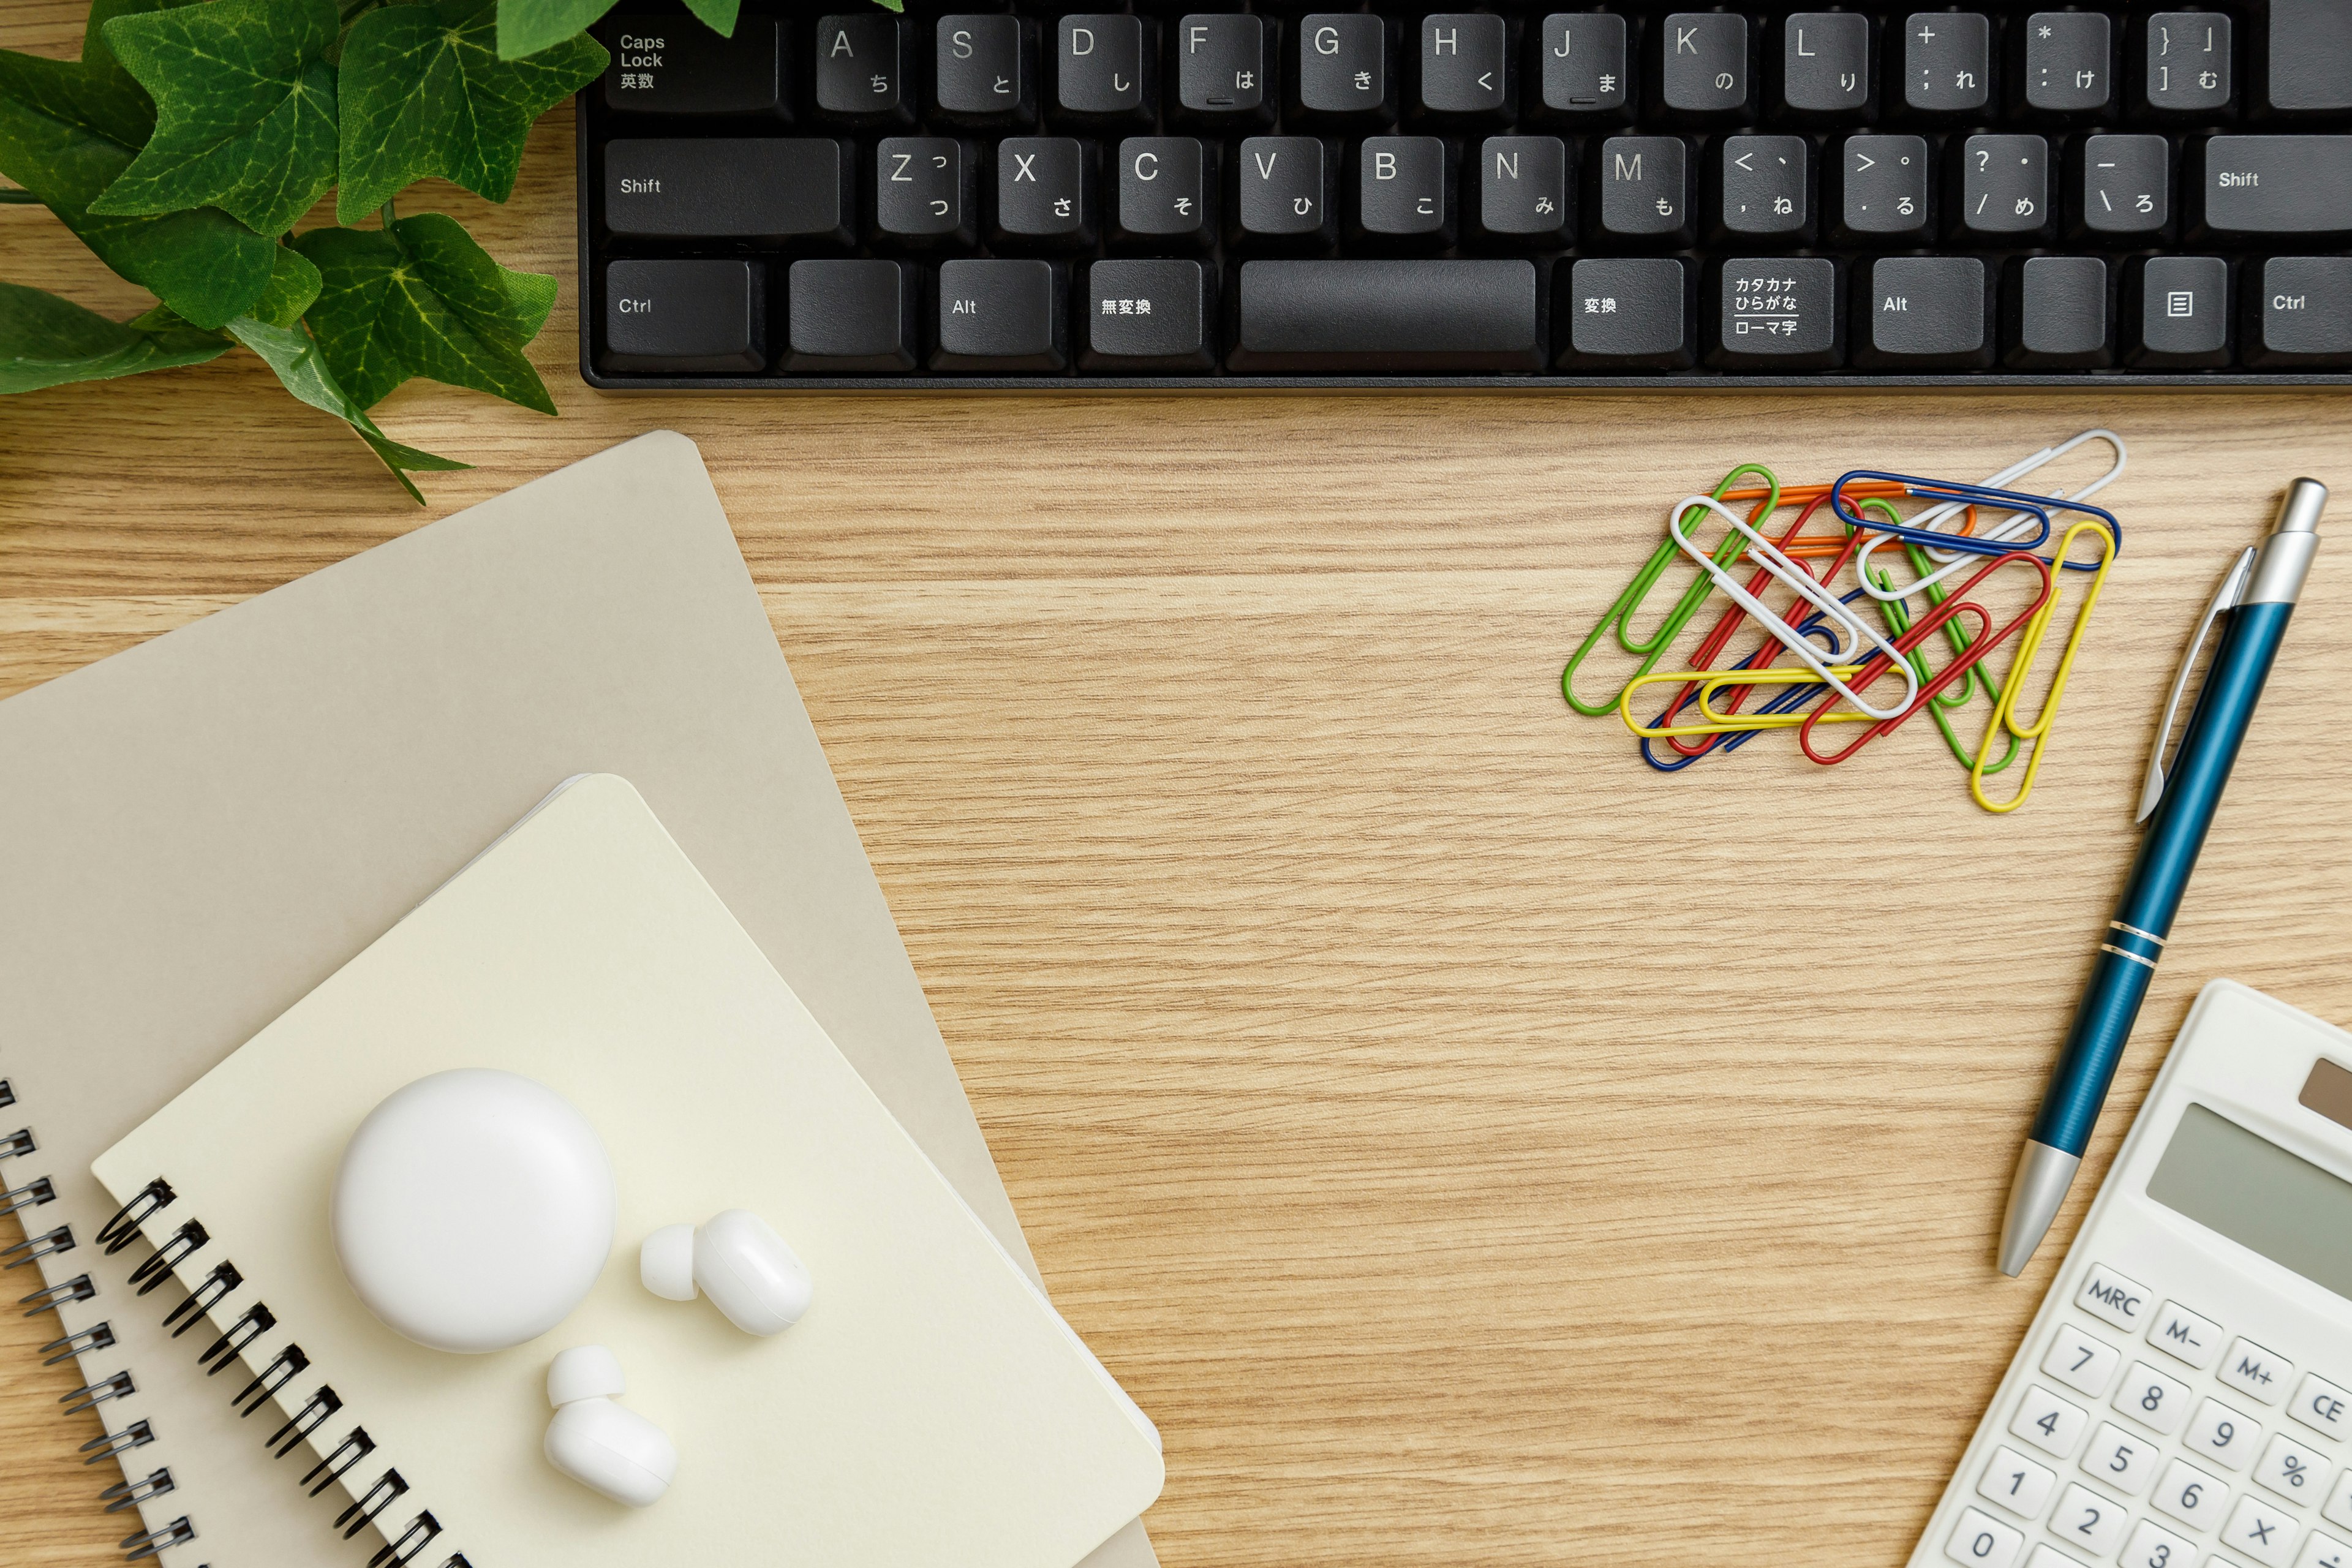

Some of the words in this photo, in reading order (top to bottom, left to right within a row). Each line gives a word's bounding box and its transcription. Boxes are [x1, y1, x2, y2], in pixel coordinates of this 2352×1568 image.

[620, 34, 665, 52] Caps
[831, 30, 854, 58] A
[952, 31, 972, 58] S
[1072, 28, 1094, 55] D
[1190, 27, 1208, 54] F
[1314, 26, 1339, 55] G
[1435, 28, 1457, 55] H
[1554, 30, 1570, 58] J
[1677, 27, 1698, 55] K
[1798, 29, 1815, 56] L
[2160, 27, 2169, 56] }
[621, 53, 663, 67] Lock
[620, 73, 654, 89] 英数
[870, 74, 888, 93] ち
[993, 75, 1009, 94] と
[1114, 73, 1130, 92] し
[1236, 70, 1254, 89] は
[1354, 71, 1371, 90] き
[1477, 72, 1493, 91] く
[1599, 74, 1616, 92] ま
[1715, 72, 1733, 90] の
[1841, 73, 1855, 92] り
[1956, 70, 1975, 89] れ
[2076, 70, 2095, 89] け
[2160, 66, 2168, 91] ]
[2199, 70, 2217, 89] む
[891, 154, 913, 181] Z
[1014, 154, 1036, 182] X
[1134, 153, 1158, 181] C
[1254, 153, 1276, 180] V
[1376, 153, 1396, 180] B
[1497, 152, 1518, 179] N
[1615, 153, 1642, 181] M
[1734, 153, 1753, 172] <
[1856, 153, 1875, 172] >
[1976, 150, 1989, 172] ?
[620, 179, 660, 194] Shift
[2219, 172, 2259, 187] Shift
[930, 200, 948, 216] つ
[1054, 198, 1071, 217] さ
[1174, 197, 1193, 216] そ
[1294, 197, 1313, 215] ひ
[1417, 198, 1433, 214] こ
[1536, 197, 1554, 214] み
[1656, 197, 1673, 216] も
[1773, 196, 1793, 215] ね
[1896, 197, 1914, 215] る
[1976, 194, 1988, 215] /
[2015, 197, 2034, 216] め
[2135, 194, 2154, 213] ろ
[1736, 277, 1796, 292] カタカナ
[619, 298, 650, 313] Ctrl
[952, 300, 976, 314] Alt
[1101, 298, 1151, 315] 無変換
[1584, 297, 1616, 314] 変換
[1735, 295, 1796, 311] ひらがな
[1883, 296, 1907, 311] Alt
[2273, 295, 2305, 310] Ctrl
[1736, 320, 1797, 336] ローマ字
[2087, 1279, 2141, 1318] MRC
[2070, 1346, 2094, 1372] 7
[2236, 1355, 2274, 1385] M+
[2141, 1385, 2163, 1411] 8
[2313, 1395, 2345, 1423] CE
[2037, 1412, 2059, 1436] 4
[2212, 1422, 2234, 1447] 9
[2109, 1446, 2133, 1472] 5
[2282, 1455, 2307, 1487] %
[2010, 1472, 2026, 1496] 1
[2181, 1483, 2203, 1509] 6
[2078, 1509, 2100, 1536] 2
[2149, 1545, 2171, 1568] 3
